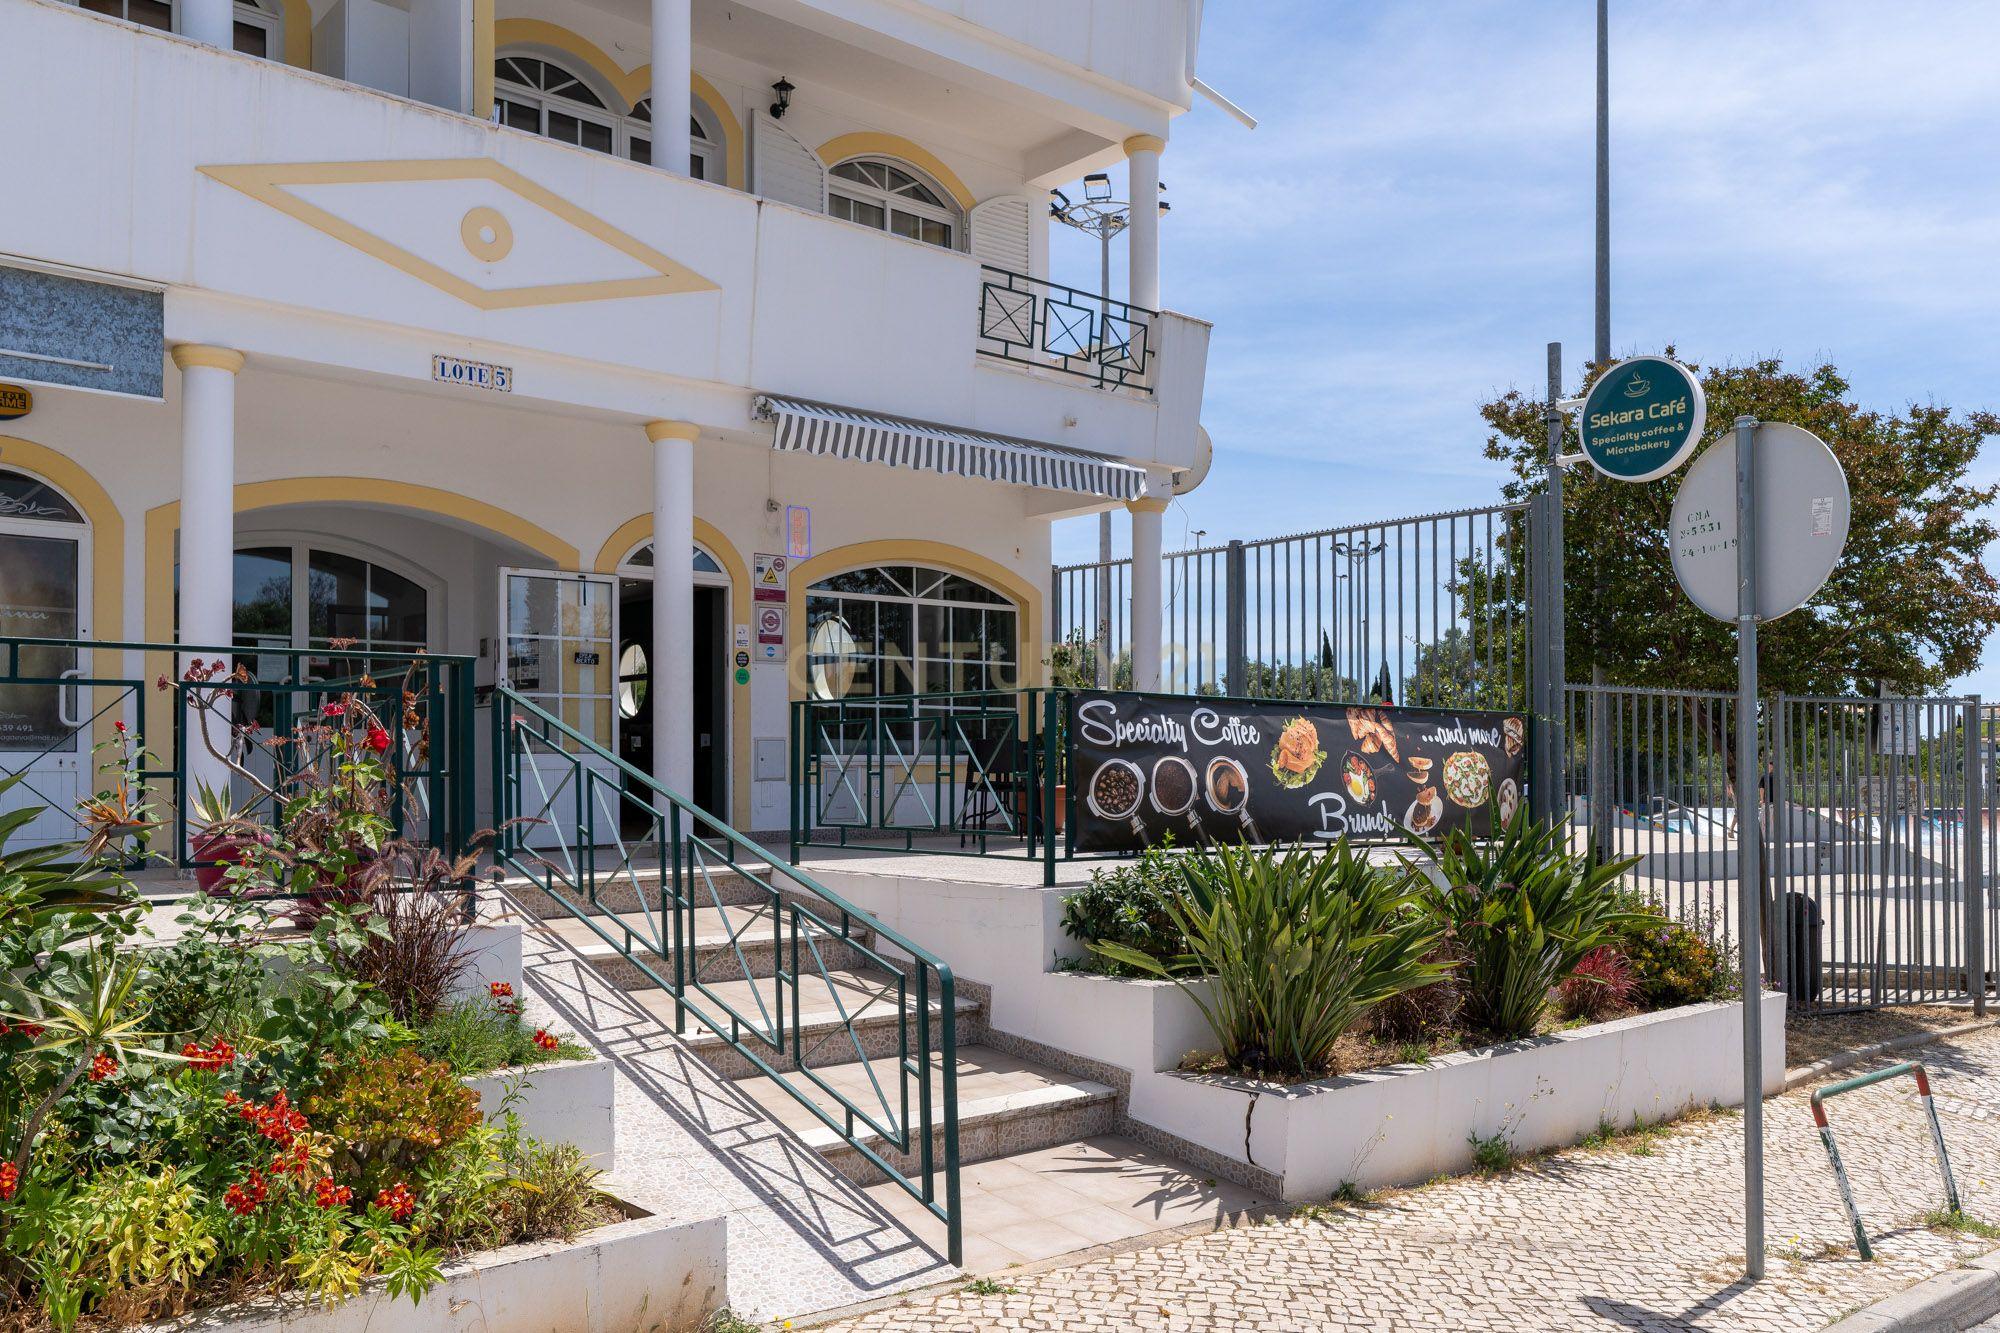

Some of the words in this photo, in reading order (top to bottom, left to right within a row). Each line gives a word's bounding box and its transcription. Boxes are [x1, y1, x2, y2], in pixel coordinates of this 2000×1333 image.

[440, 362, 489, 384] LOTE
[495, 370, 506, 387] 5
[1590, 408, 1644, 429] Sekara
[1648, 397, 1686, 419] Café
[1592, 431, 1640, 446] Specialty
[1641, 425, 1675, 438] coffee
[1677, 422, 1684, 431] &
[1606, 440, 1670, 456] Microbakery
[1078, 700, 1188, 752] Specialty
[1191, 707, 1260, 746] Coffee
[1468, 727, 1501, 748] more
[1308, 792, 1396, 838] Brunch
